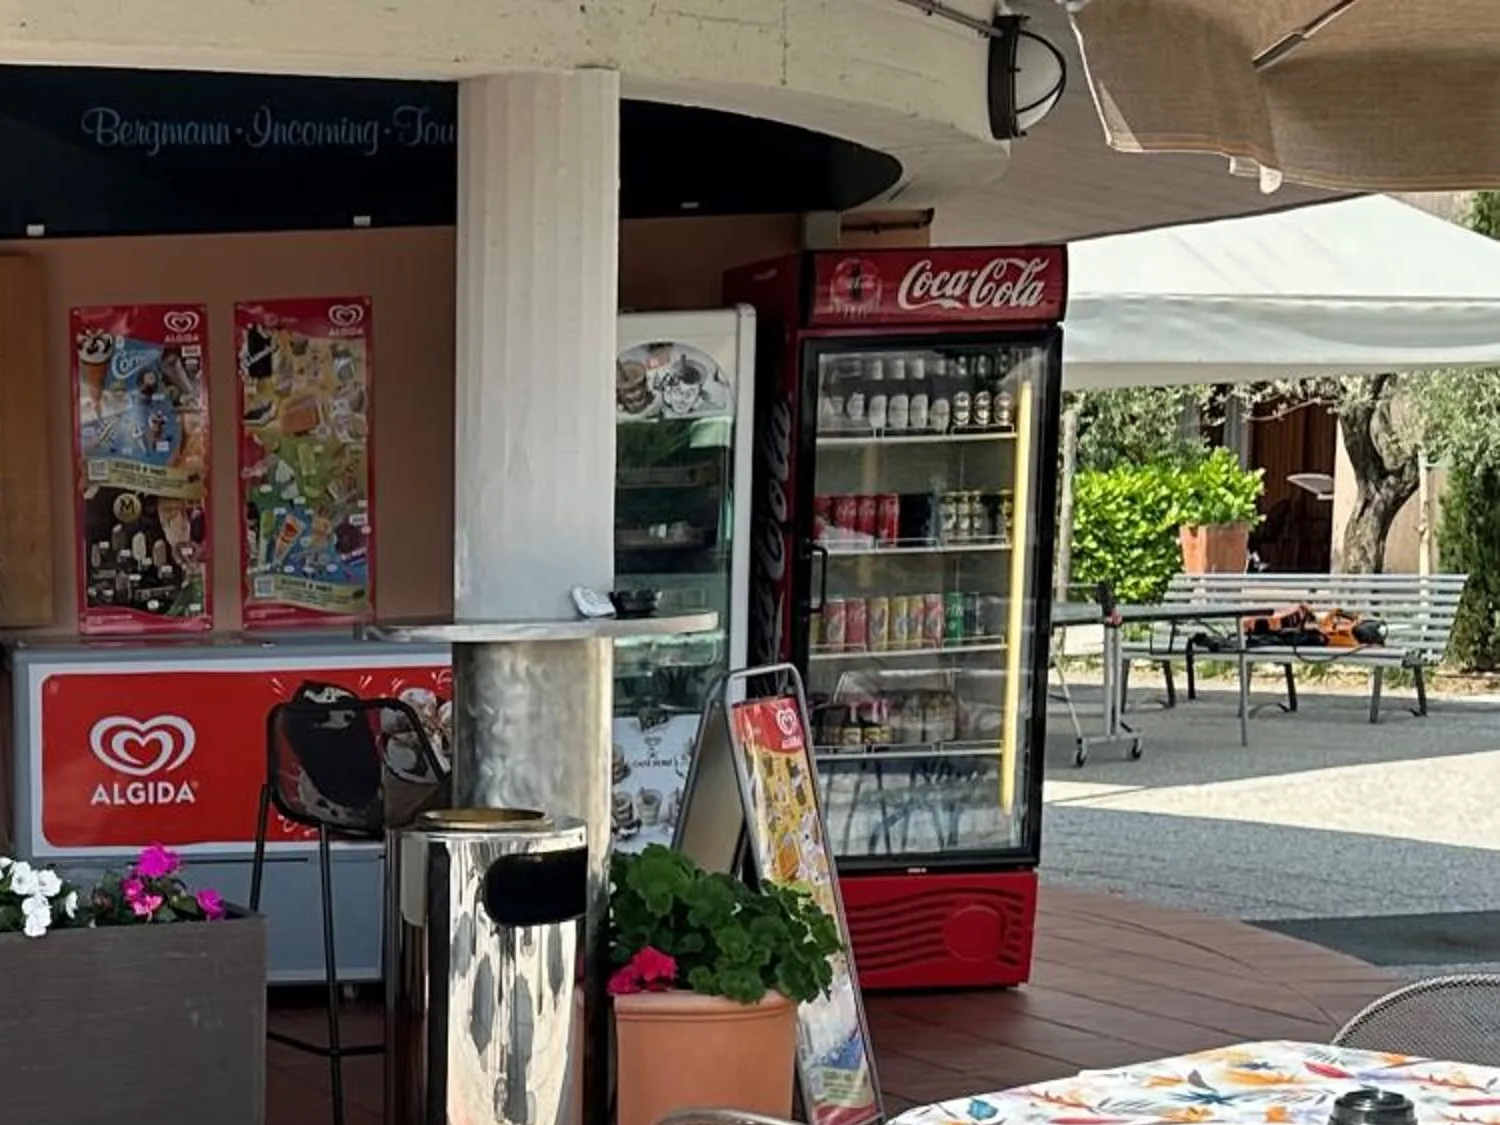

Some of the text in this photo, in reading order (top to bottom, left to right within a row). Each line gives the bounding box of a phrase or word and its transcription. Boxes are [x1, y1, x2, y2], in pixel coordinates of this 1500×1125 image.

[81, 106, 230, 156] Bergmann
[245, 103, 379, 156] Incoming
[897, 257, 1049, 311] Coca-Cola
[90, 780, 196, 805] ALGIDA
